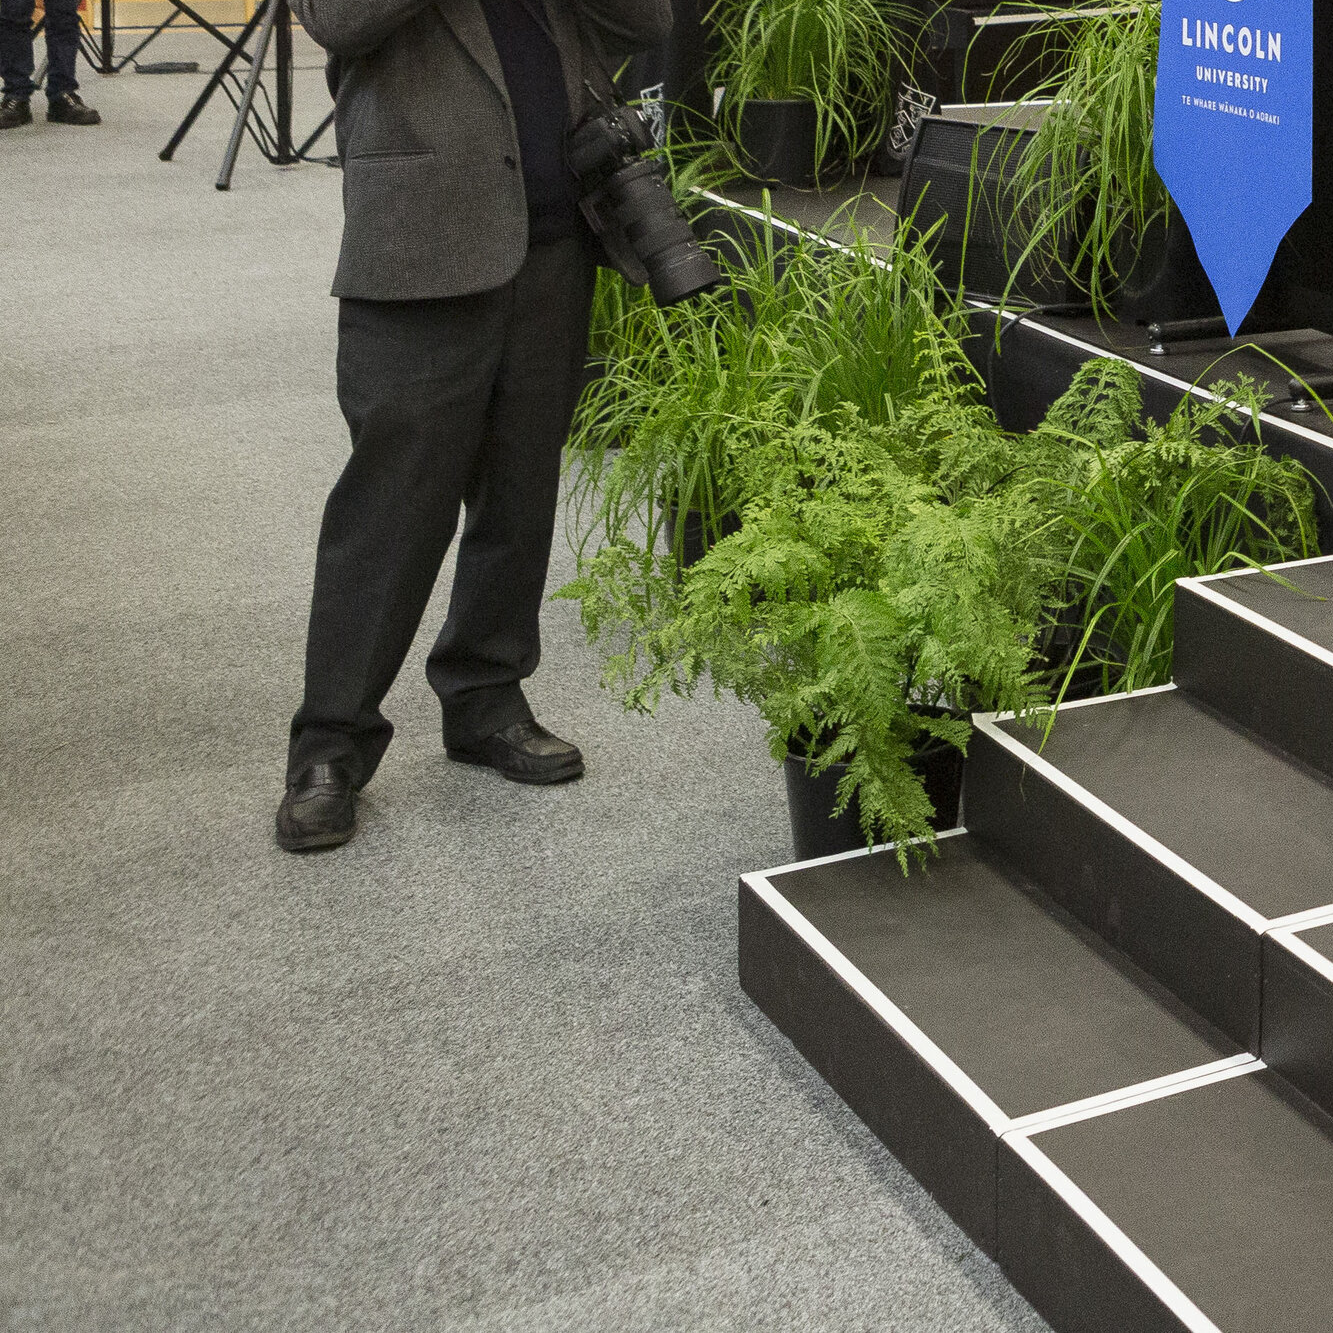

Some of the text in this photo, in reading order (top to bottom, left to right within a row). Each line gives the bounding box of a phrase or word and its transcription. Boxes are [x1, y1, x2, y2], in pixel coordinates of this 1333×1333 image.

[1182, 17, 1281, 63] LINCOLN
[1196, 65, 1268, 94] UNIVERSITY
[1182, 95, 1191, 105] TE
[1193, 97, 1217, 111] WHARE
[1249, 109, 1255, 119] O
[1256, 111, 1280, 125] AORAKI
